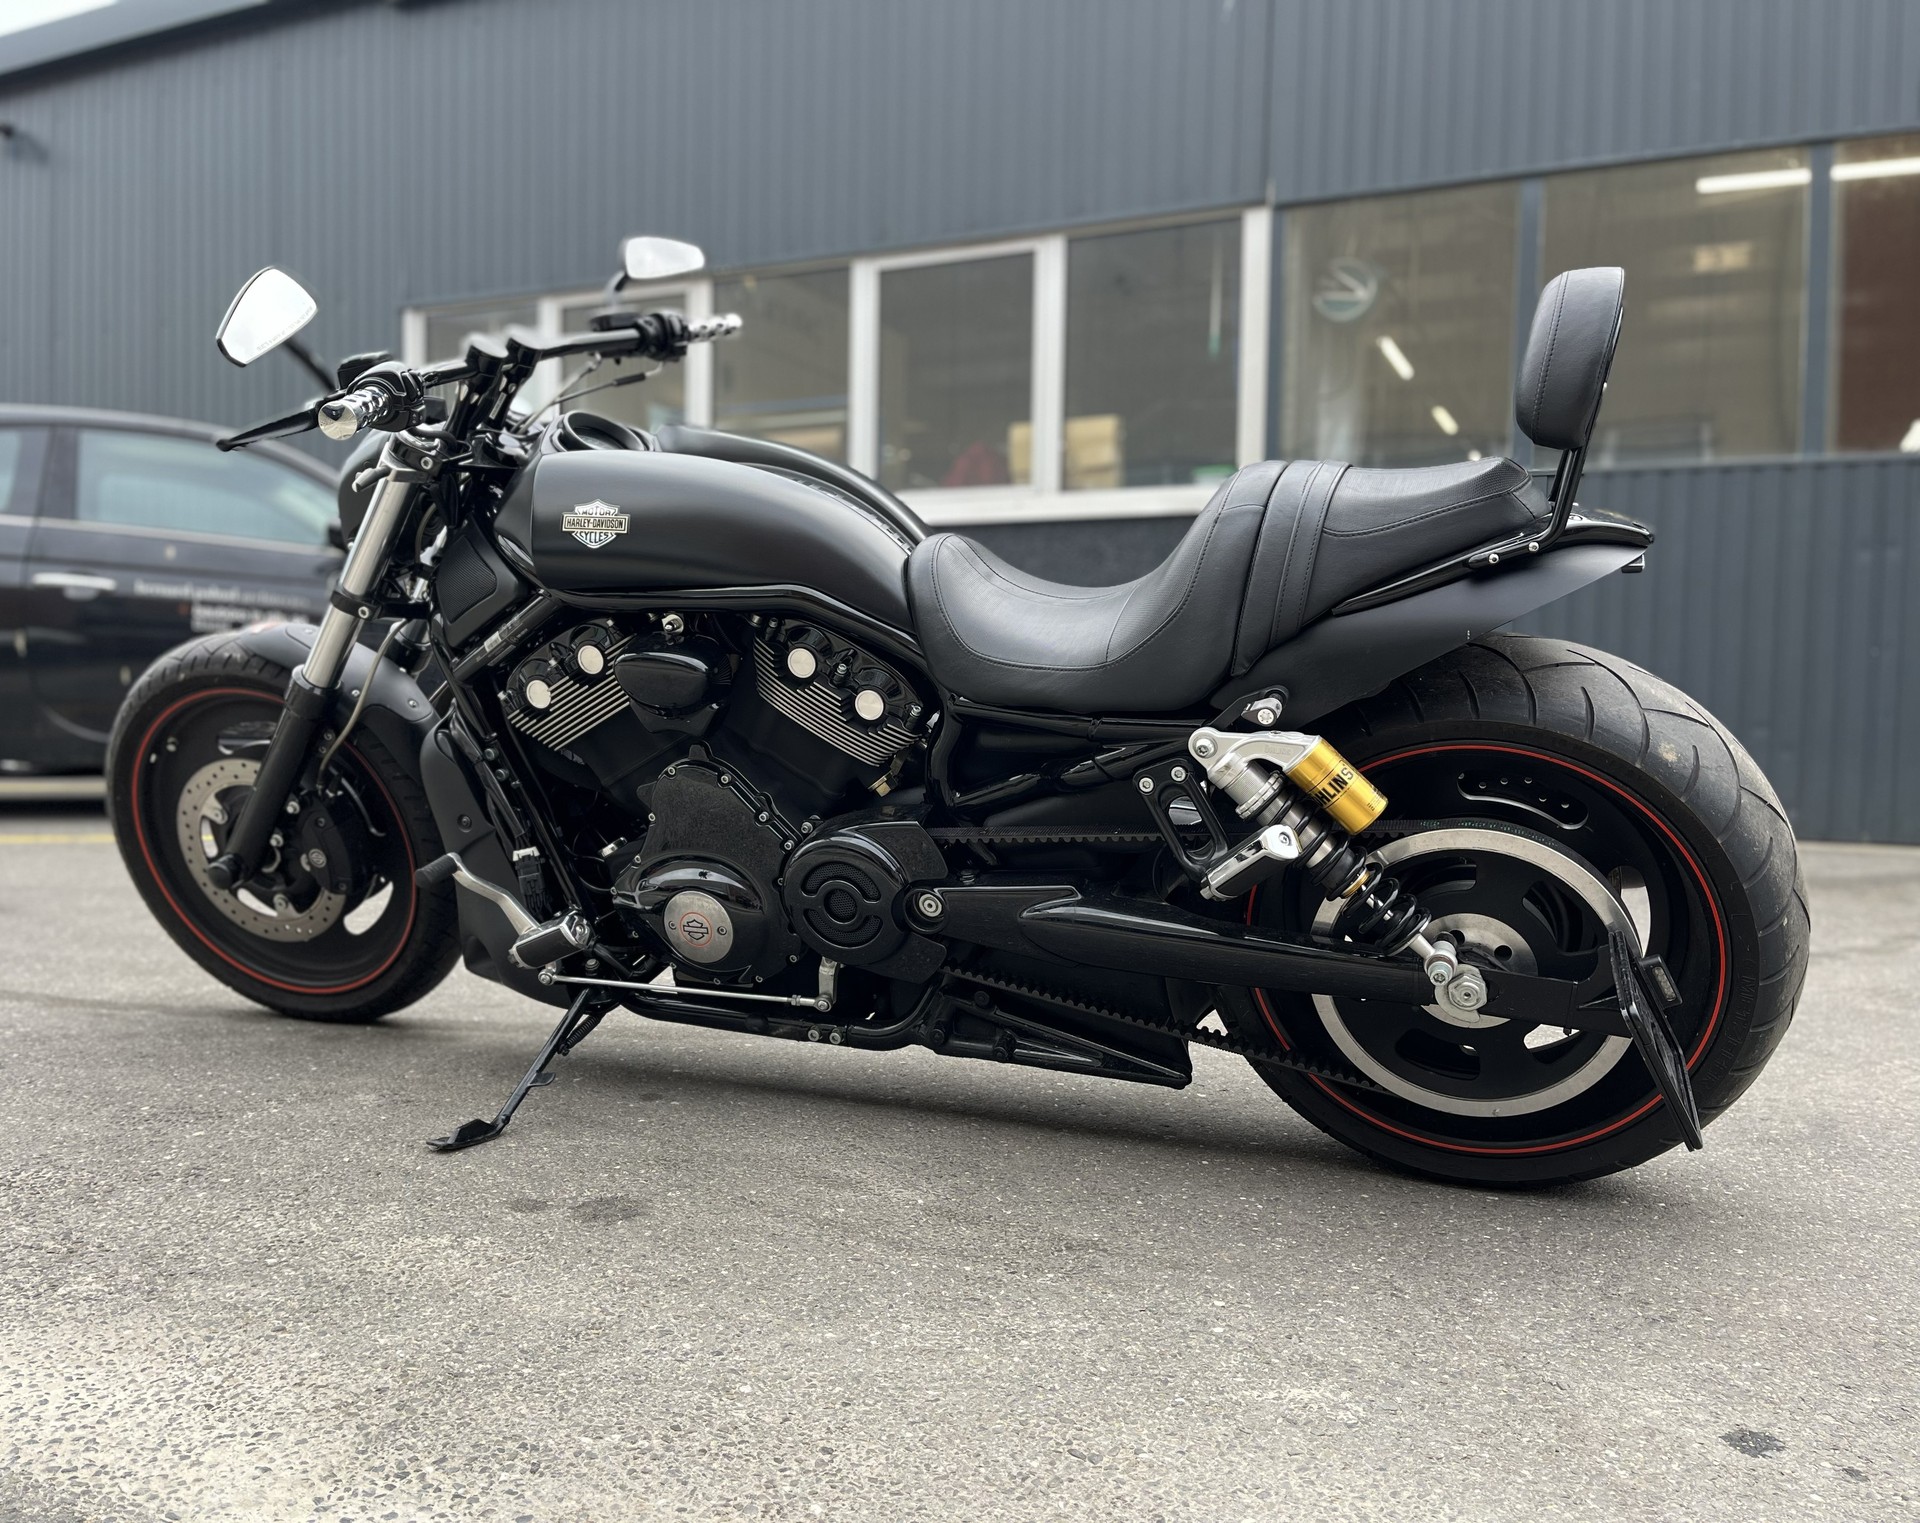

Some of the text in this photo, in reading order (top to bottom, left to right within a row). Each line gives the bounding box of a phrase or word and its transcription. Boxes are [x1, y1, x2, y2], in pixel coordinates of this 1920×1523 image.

[581, 506, 611, 515] MOTOR
[566, 518, 623, 529] HARLEY-DAVIDSON
[579, 531, 609, 543] CYCLES
